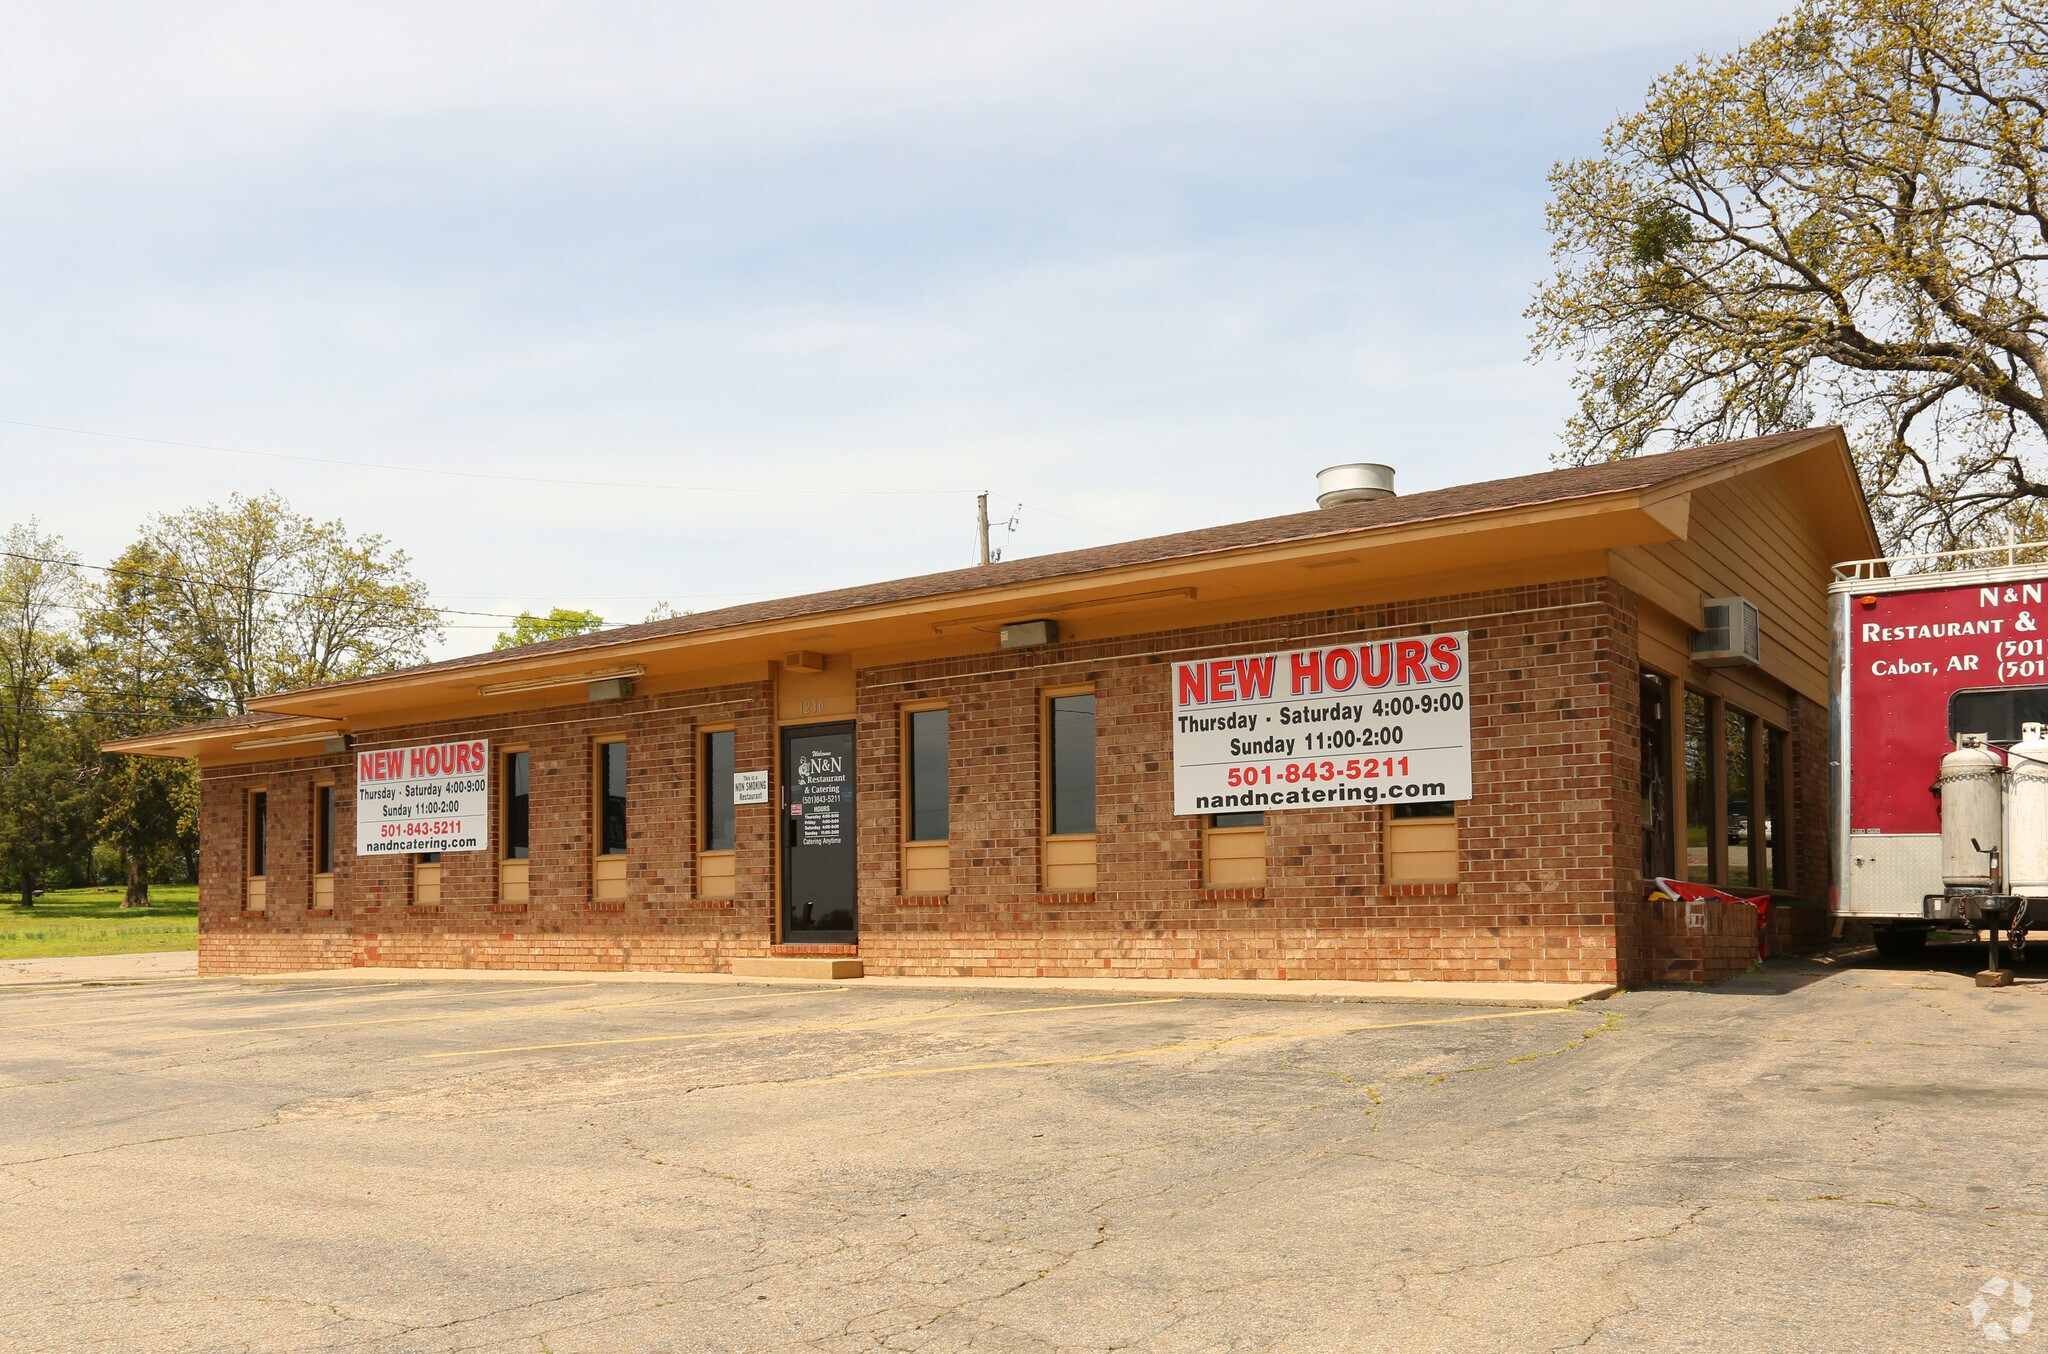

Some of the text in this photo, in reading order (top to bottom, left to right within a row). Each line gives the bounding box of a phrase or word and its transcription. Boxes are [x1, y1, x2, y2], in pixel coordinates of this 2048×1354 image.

[1862, 611, 2037, 643] RESTAURANT &
[1996, 639, 2048, 662] (501
[1178, 636, 1462, 706] NEW HOURS
[1946, 654, 1979, 672] AR
[800, 700, 824, 715] 1210
[1178, 711, 1257, 733] Thursday
[1279, 702, 1363, 726] Saturday
[1372, 691, 1464, 718] 4:00-9:00
[1230, 725, 1403, 757] Sunday 11:00-2:00
[360, 742, 486, 782] NEW HOURS
[810, 757, 842, 774] N&N
[807, 774, 846, 784] Restaurant
[1227, 756, 1409, 788] 501-843-5211
[360, 787, 396, 801] Thursday
[405, 783, 442, 798] Saturday
[446, 779, 486, 794] 4:00-9:00
[735, 780, 766, 792] NON SMOKING
[804, 784, 840, 794] & Catering
[739, 792, 763, 801] Restaurant
[1196, 782, 1446, 810] nandncatering.com
[382, 800, 459, 817] Sunday 11:00-2:00
[814, 805, 830, 813] HOURS
[381, 820, 461, 838] 501-843-5211
[366, 837, 477, 852] nandncatering.com
[803, 837, 842, 846] Catering Anytime
